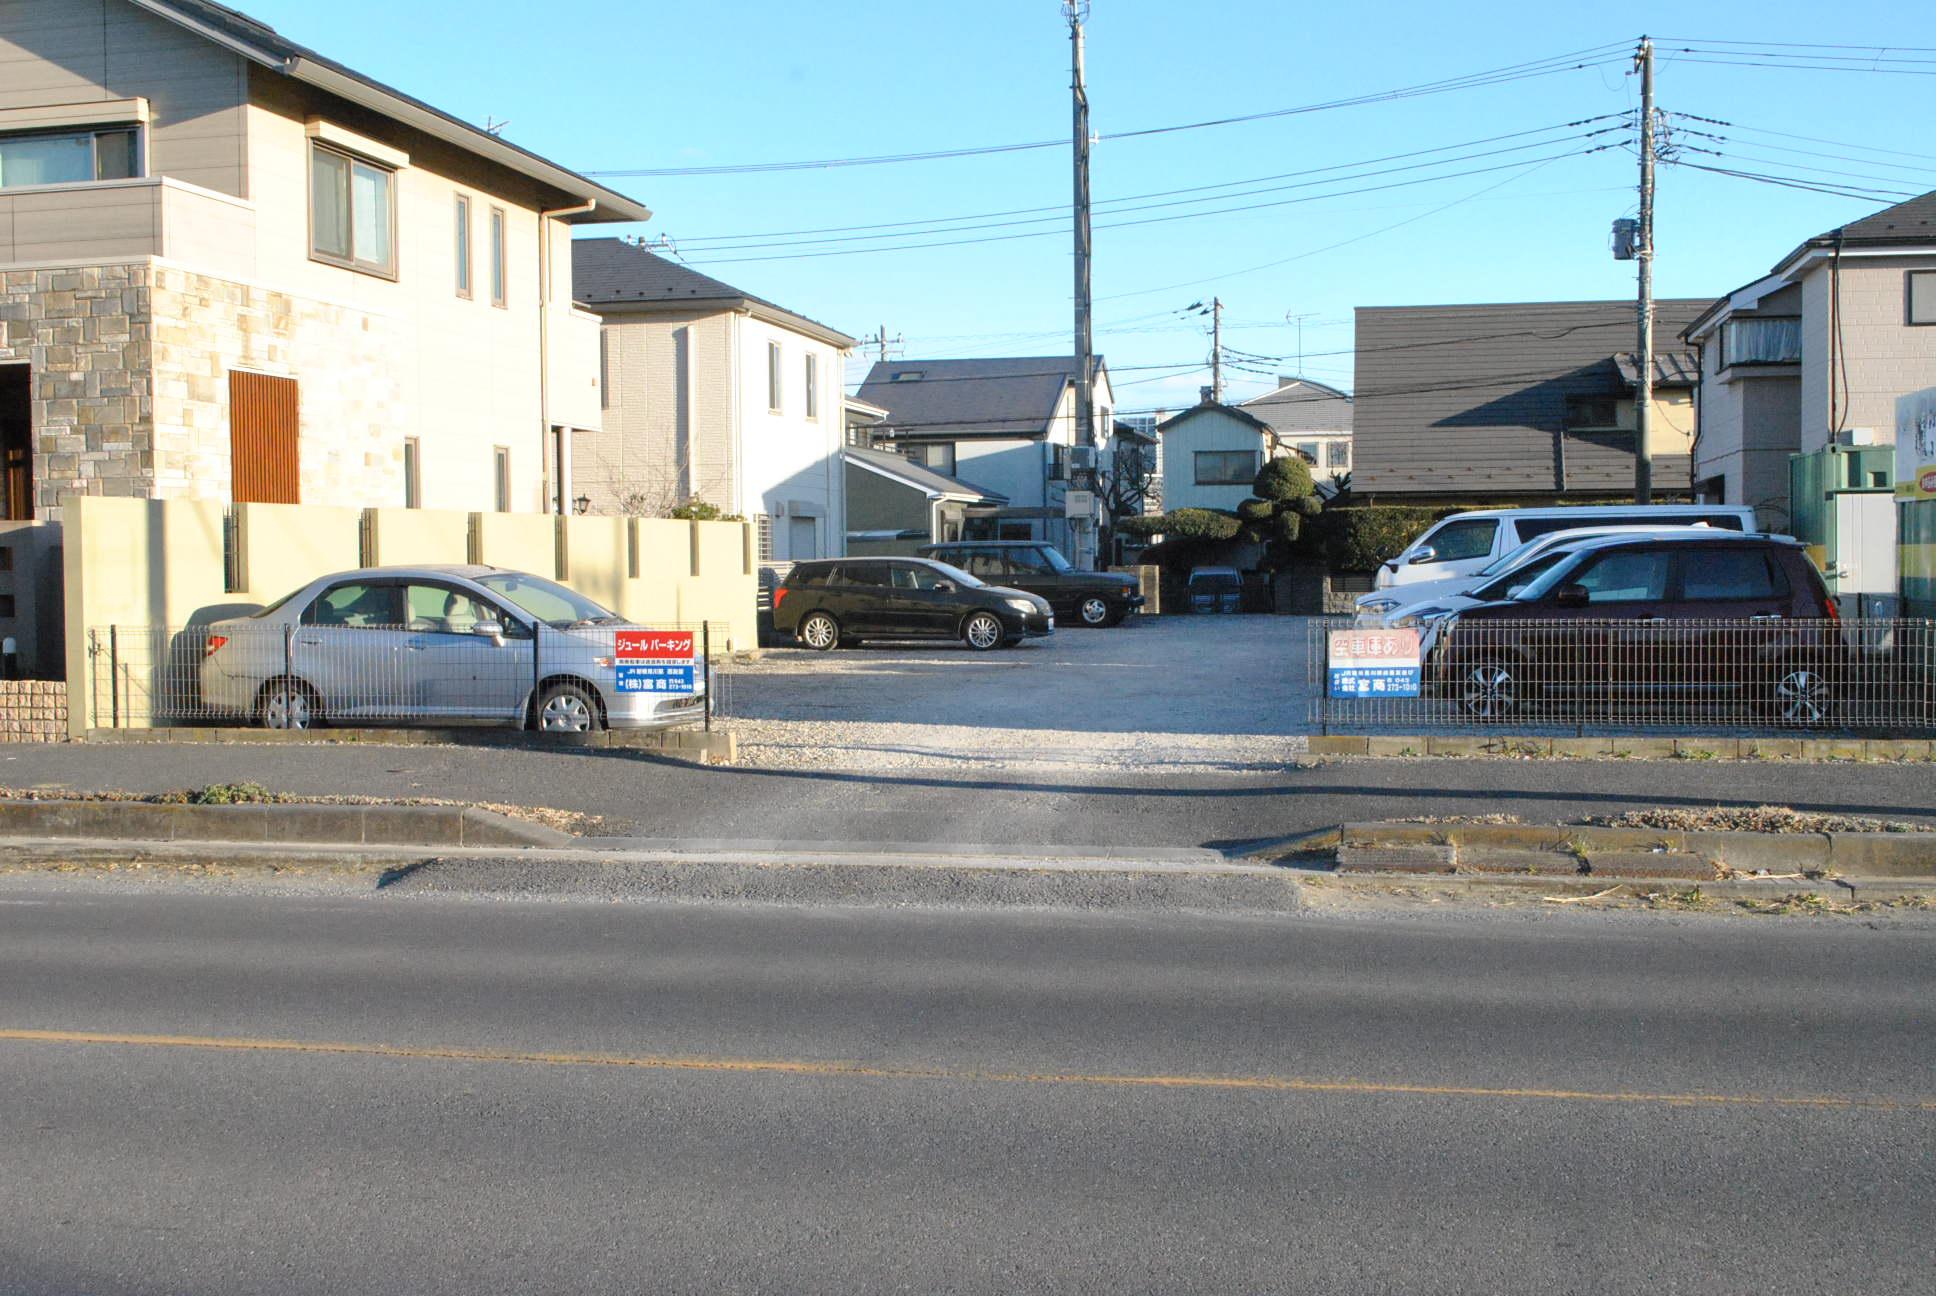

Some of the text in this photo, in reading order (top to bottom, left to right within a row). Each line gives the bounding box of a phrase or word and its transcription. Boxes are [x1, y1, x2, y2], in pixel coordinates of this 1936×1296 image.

[617, 638, 691, 651] ジュール パーキング
[1334, 636, 1414, 656] 空車庫あり
